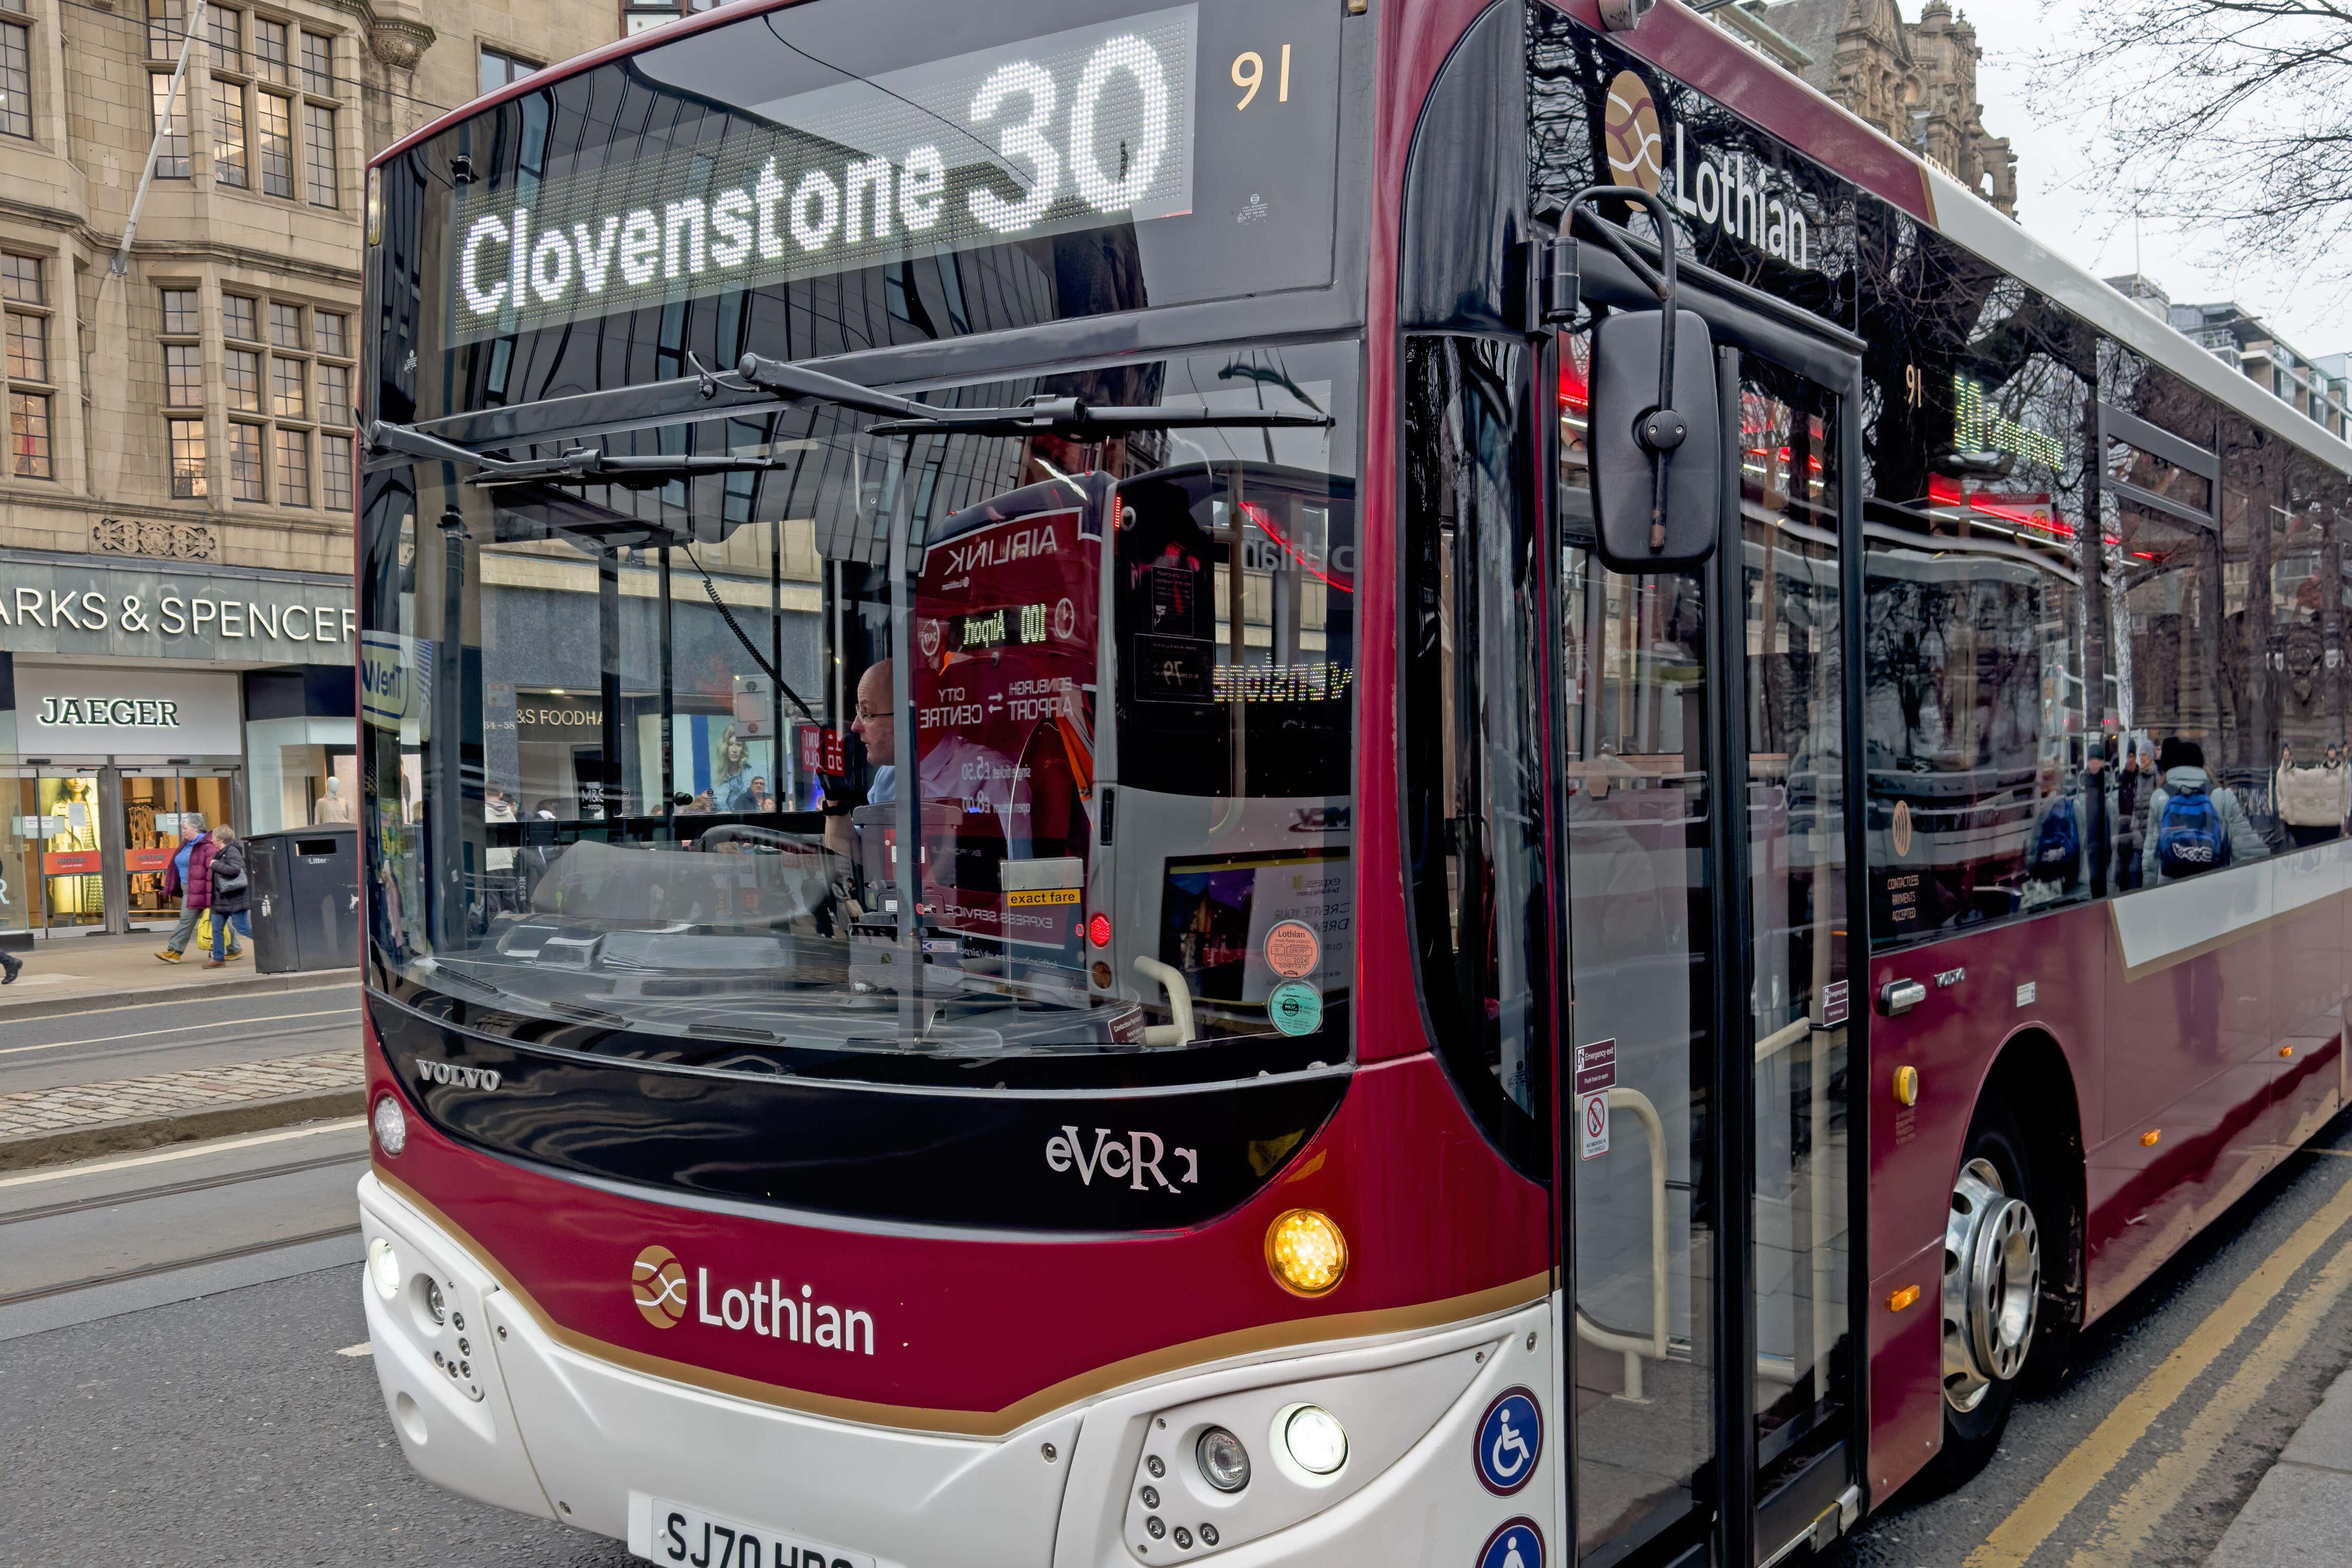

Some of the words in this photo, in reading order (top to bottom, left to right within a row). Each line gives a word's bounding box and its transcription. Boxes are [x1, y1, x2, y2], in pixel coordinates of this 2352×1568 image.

[1232, 44, 1290, 111] 91
[460, 145, 947, 314] Clovenstone
[969, 33, 1170, 234] 30
[1676, 122, 1807, 271] Lothian
[1905, 364, 1922, 408] 91
[121, 595, 150, 633] &
[38, 698, 179, 726] JAEGER
[1010, 893, 1045, 904] exact
[1049, 892, 1076, 903] fare
[1887, 874, 1919, 890] CONTACTLESS
[1892, 907, 1916, 922] ACCEPTED
[1585, 1049, 1606, 1061] Emergency
[415, 1059, 502, 1092] VOLVO
[699, 1267, 875, 1355] Lothian
[667, 1512, 761, 1568] SJ70
